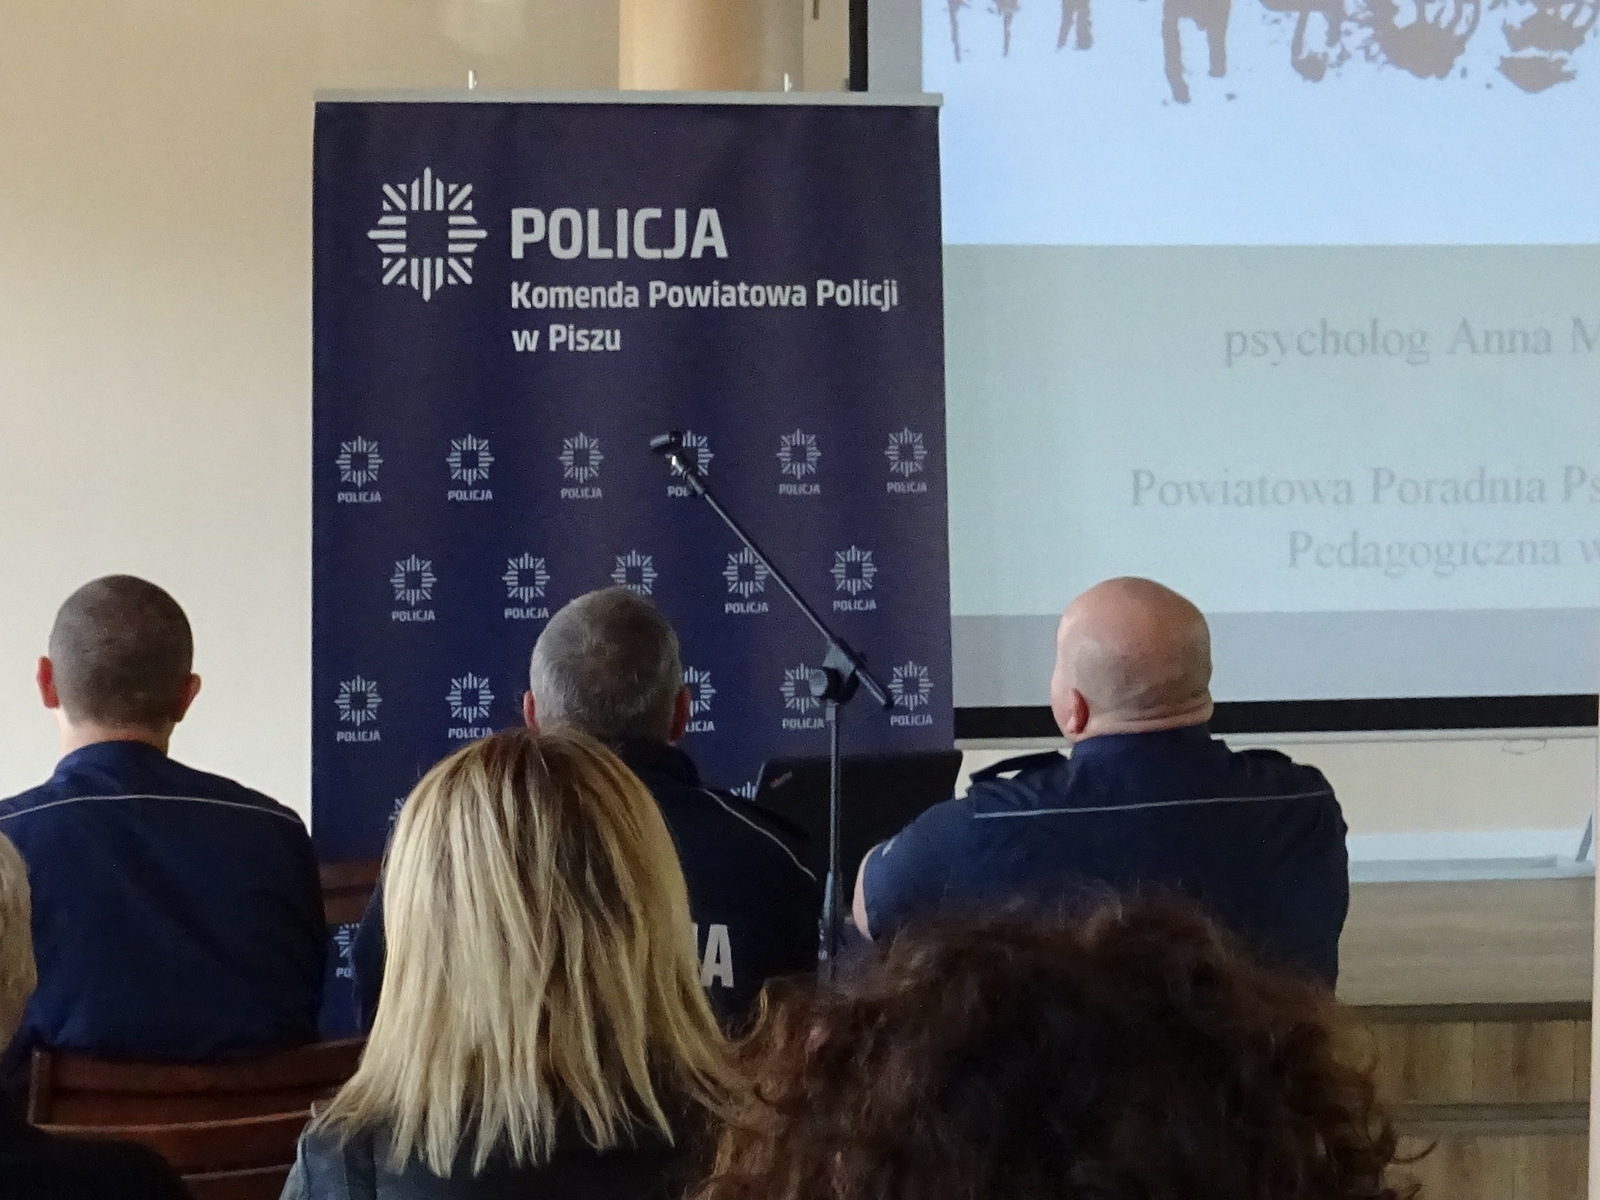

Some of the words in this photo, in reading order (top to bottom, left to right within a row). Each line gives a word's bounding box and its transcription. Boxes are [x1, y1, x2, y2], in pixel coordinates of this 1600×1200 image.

[511, 207, 729, 260] POLICJA
[511, 280, 640, 309] Komenda
[648, 280, 807, 308] Powiatowa
[816, 279, 898, 312] Policji
[511, 329, 540, 352] w
[549, 323, 621, 352] Piszu
[1224, 316, 1431, 368] psycholog
[1447, 316, 1553, 355] Anna
[778, 483, 821, 496] POLICJA
[886, 481, 928, 494] POLICJA
[1131, 468, 1355, 507] Powiatowa
[1370, 465, 1547, 505] Poradnia
[337, 491, 382, 503] POLICJA
[447, 489, 493, 501] POLICJA
[560, 487, 603, 499] POLICJA
[1287, 528, 1562, 578] Pedagogiczna
[724, 601, 770, 614] POLICJA
[832, 599, 877, 612] POLICJA
[391, 609, 436, 622] POLICJA
[504, 607, 549, 619] POLICJA
[781, 717, 825, 730] POLICJA
[889, 714, 934, 727] POLICJA
[336, 730, 381, 743] POLICJA
[447, 727, 494, 739] POLICJA
